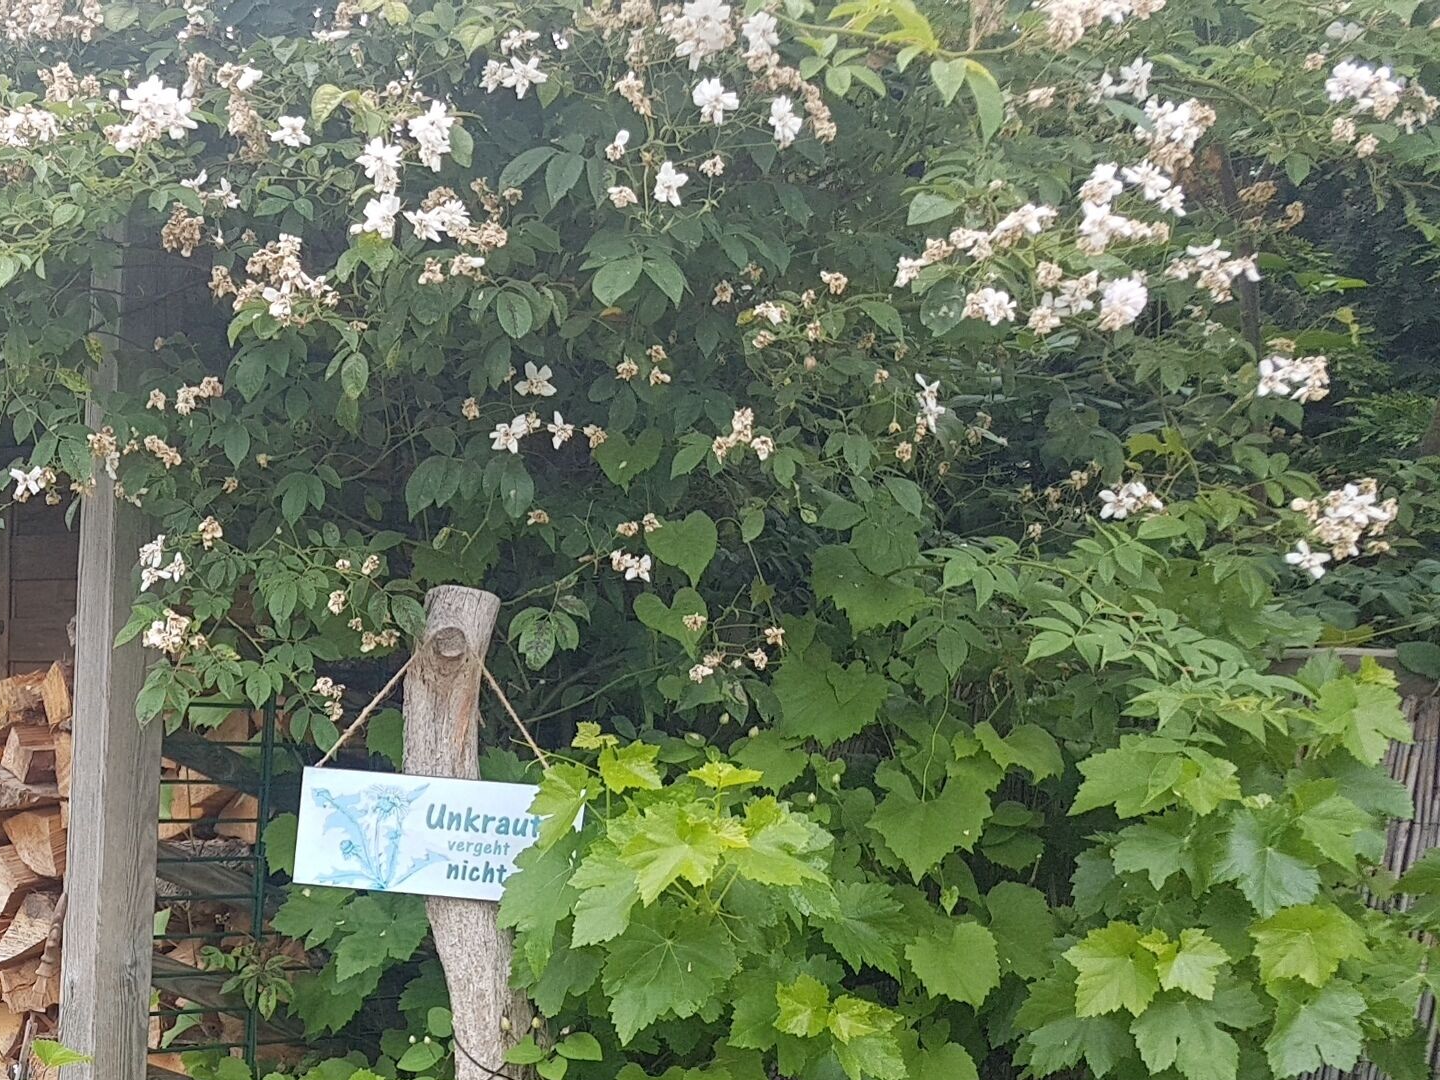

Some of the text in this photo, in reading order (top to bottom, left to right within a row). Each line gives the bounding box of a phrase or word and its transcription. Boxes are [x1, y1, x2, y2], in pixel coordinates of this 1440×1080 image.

[426, 803, 541, 838] Unkraut
[447, 839, 510, 857] vergeht
[446, 860, 507, 884] nicht
